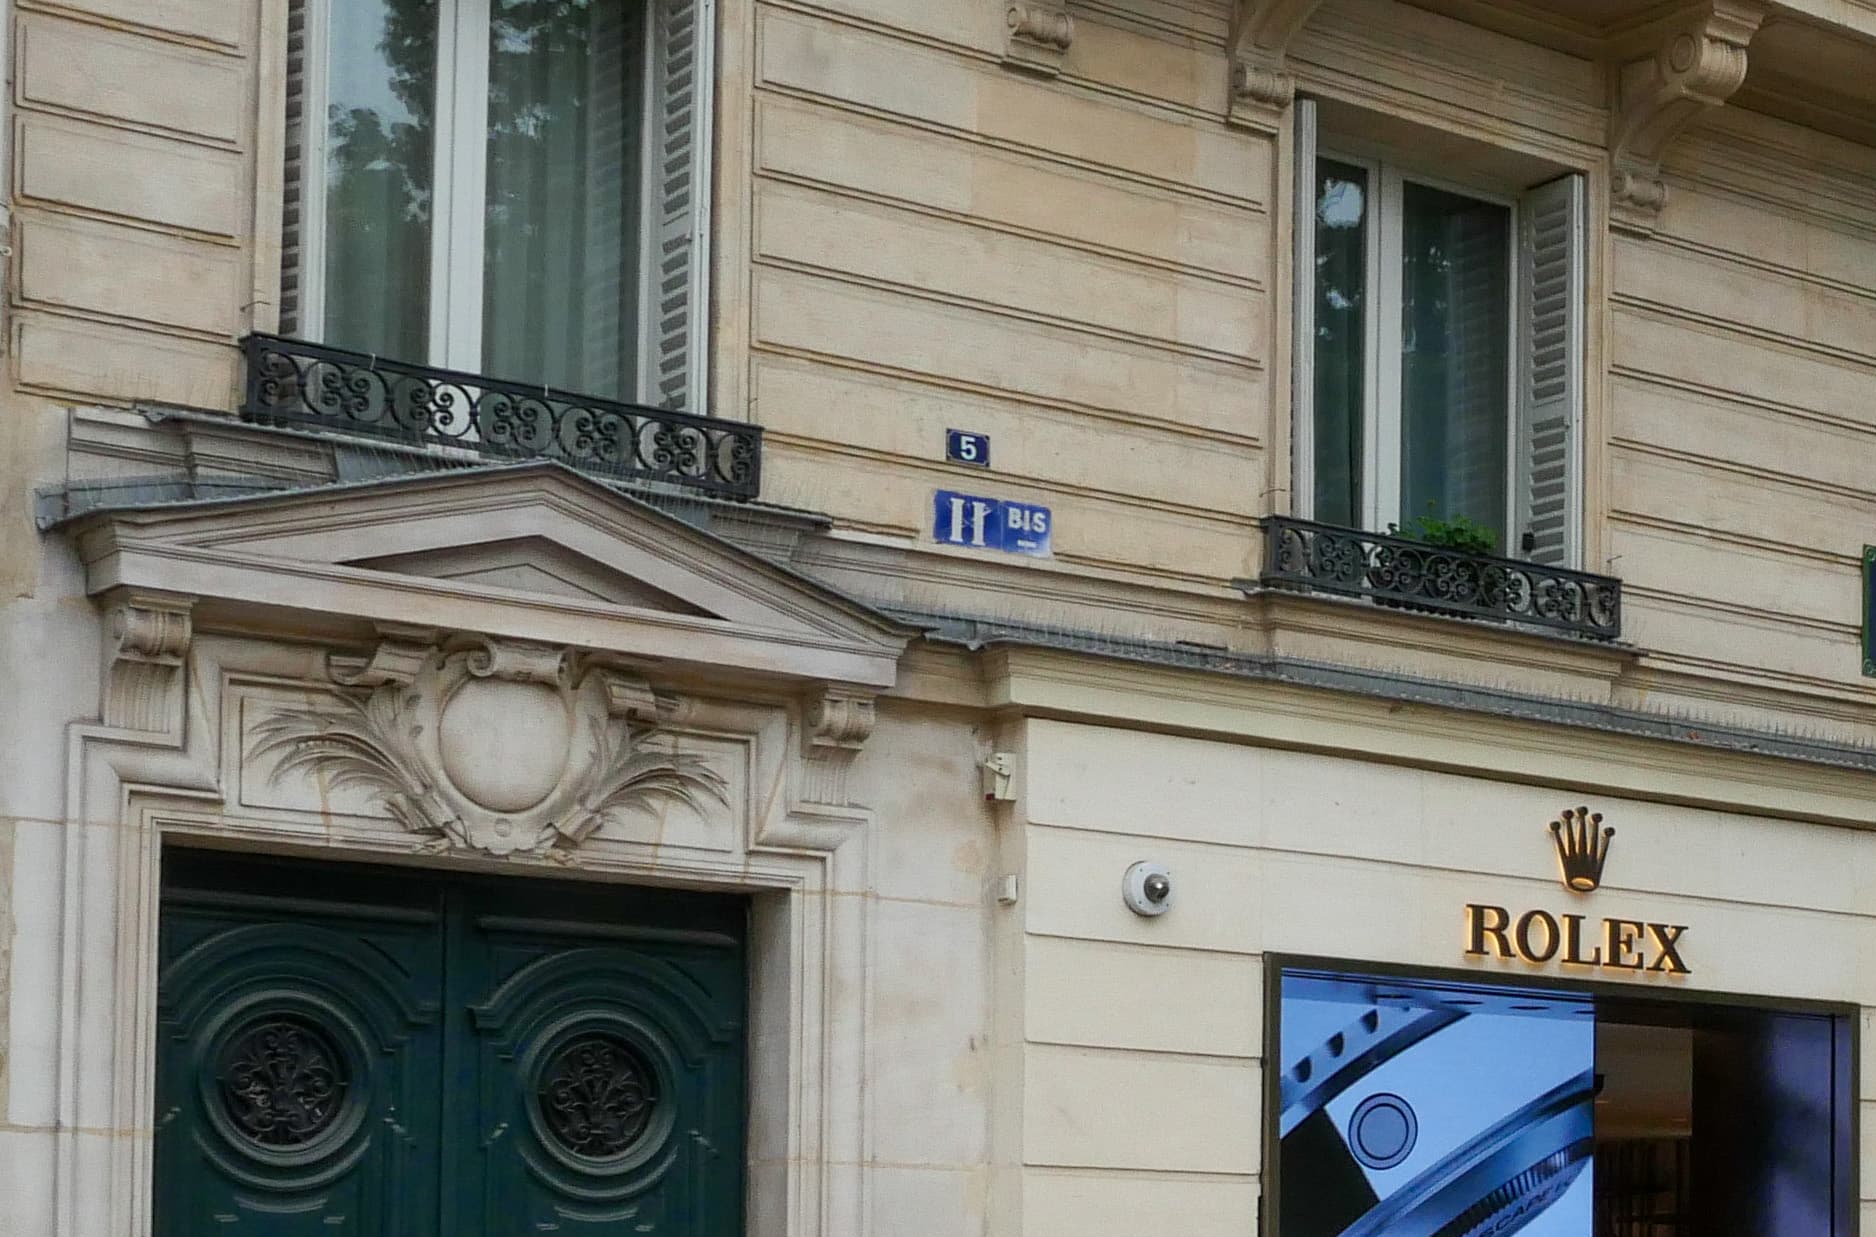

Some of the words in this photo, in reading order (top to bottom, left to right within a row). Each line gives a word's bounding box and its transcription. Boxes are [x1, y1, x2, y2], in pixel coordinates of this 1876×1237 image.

[960, 435, 977, 460] 5
[1008, 507, 1046, 533] BIS
[1464, 903, 1692, 975] ROLEX
